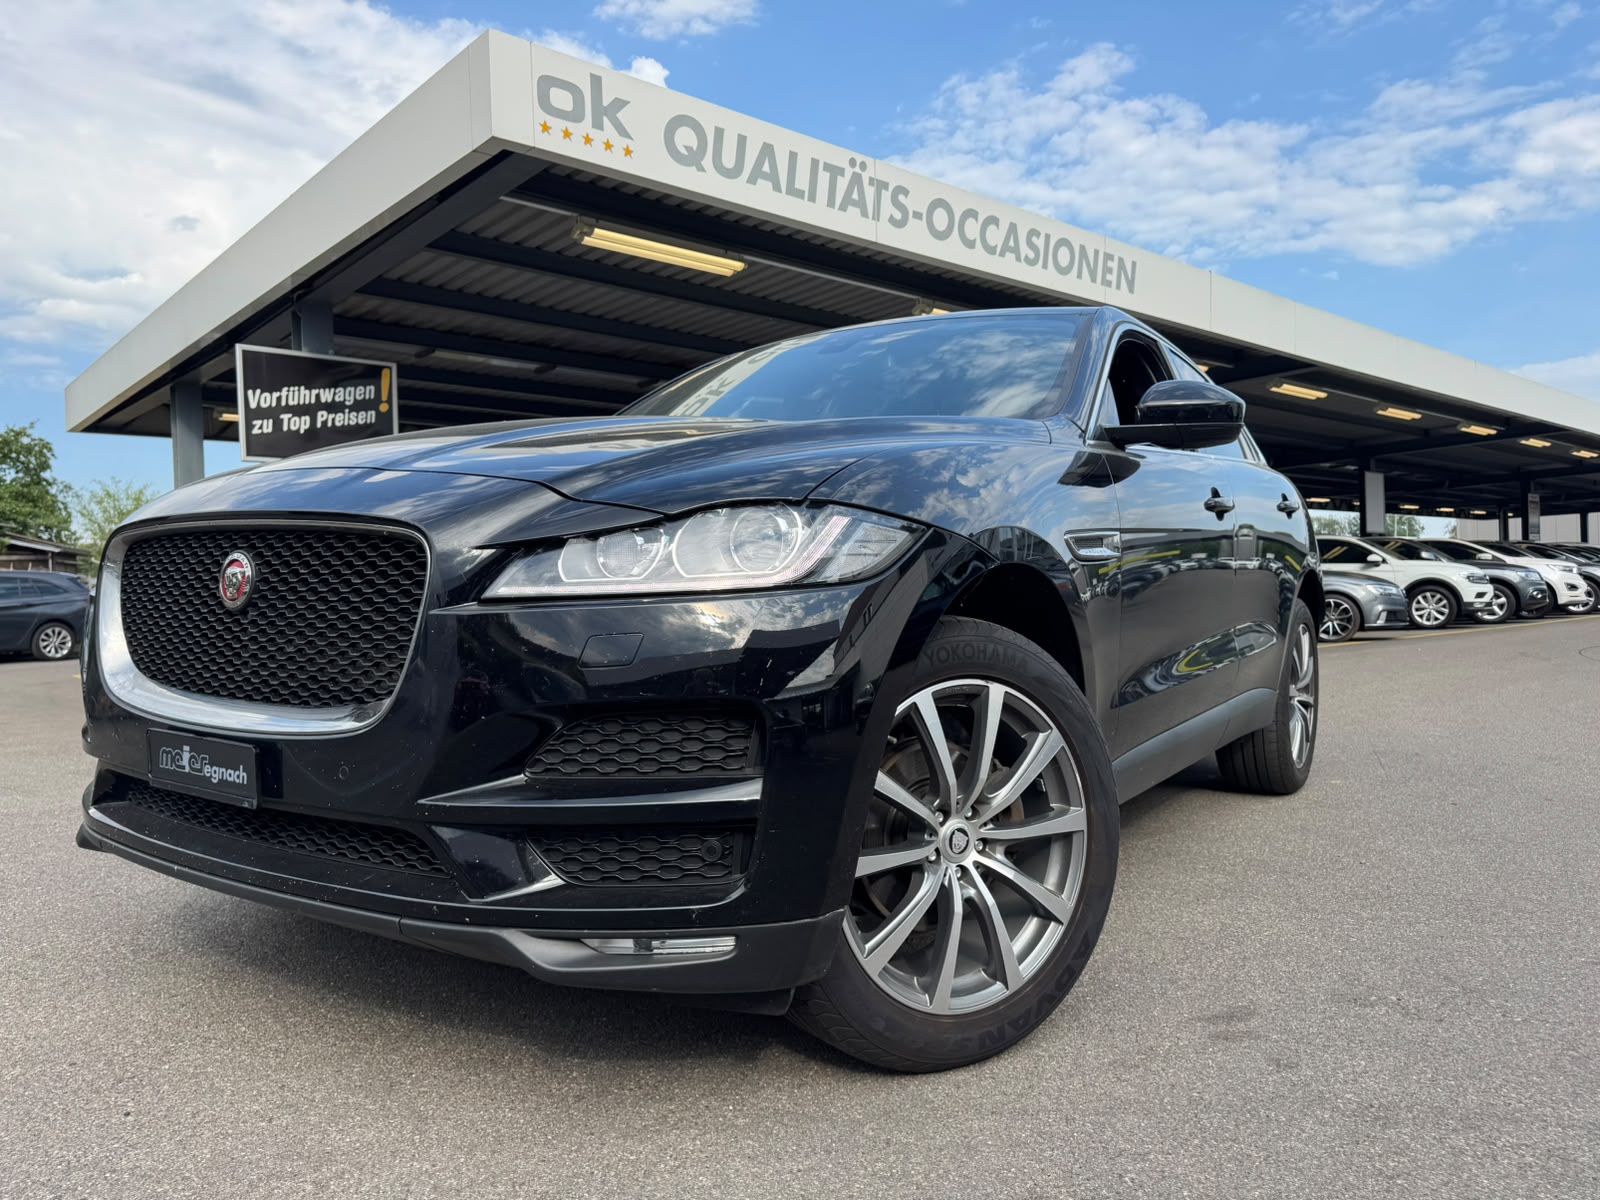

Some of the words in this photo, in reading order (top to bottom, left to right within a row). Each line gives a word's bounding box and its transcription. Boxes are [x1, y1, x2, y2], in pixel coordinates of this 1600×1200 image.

[536, 72, 634, 141] ok
[662, 113, 1137, 295] QUALITÄTS-OCCASIONEN
[247, 384, 375, 409] Vorführwagen
[251, 418, 273, 435] zu
[279, 413, 311, 434] Top
[316, 408, 376, 429] Preisen
[923, 642, 1028, 673] YOKOHAMA
